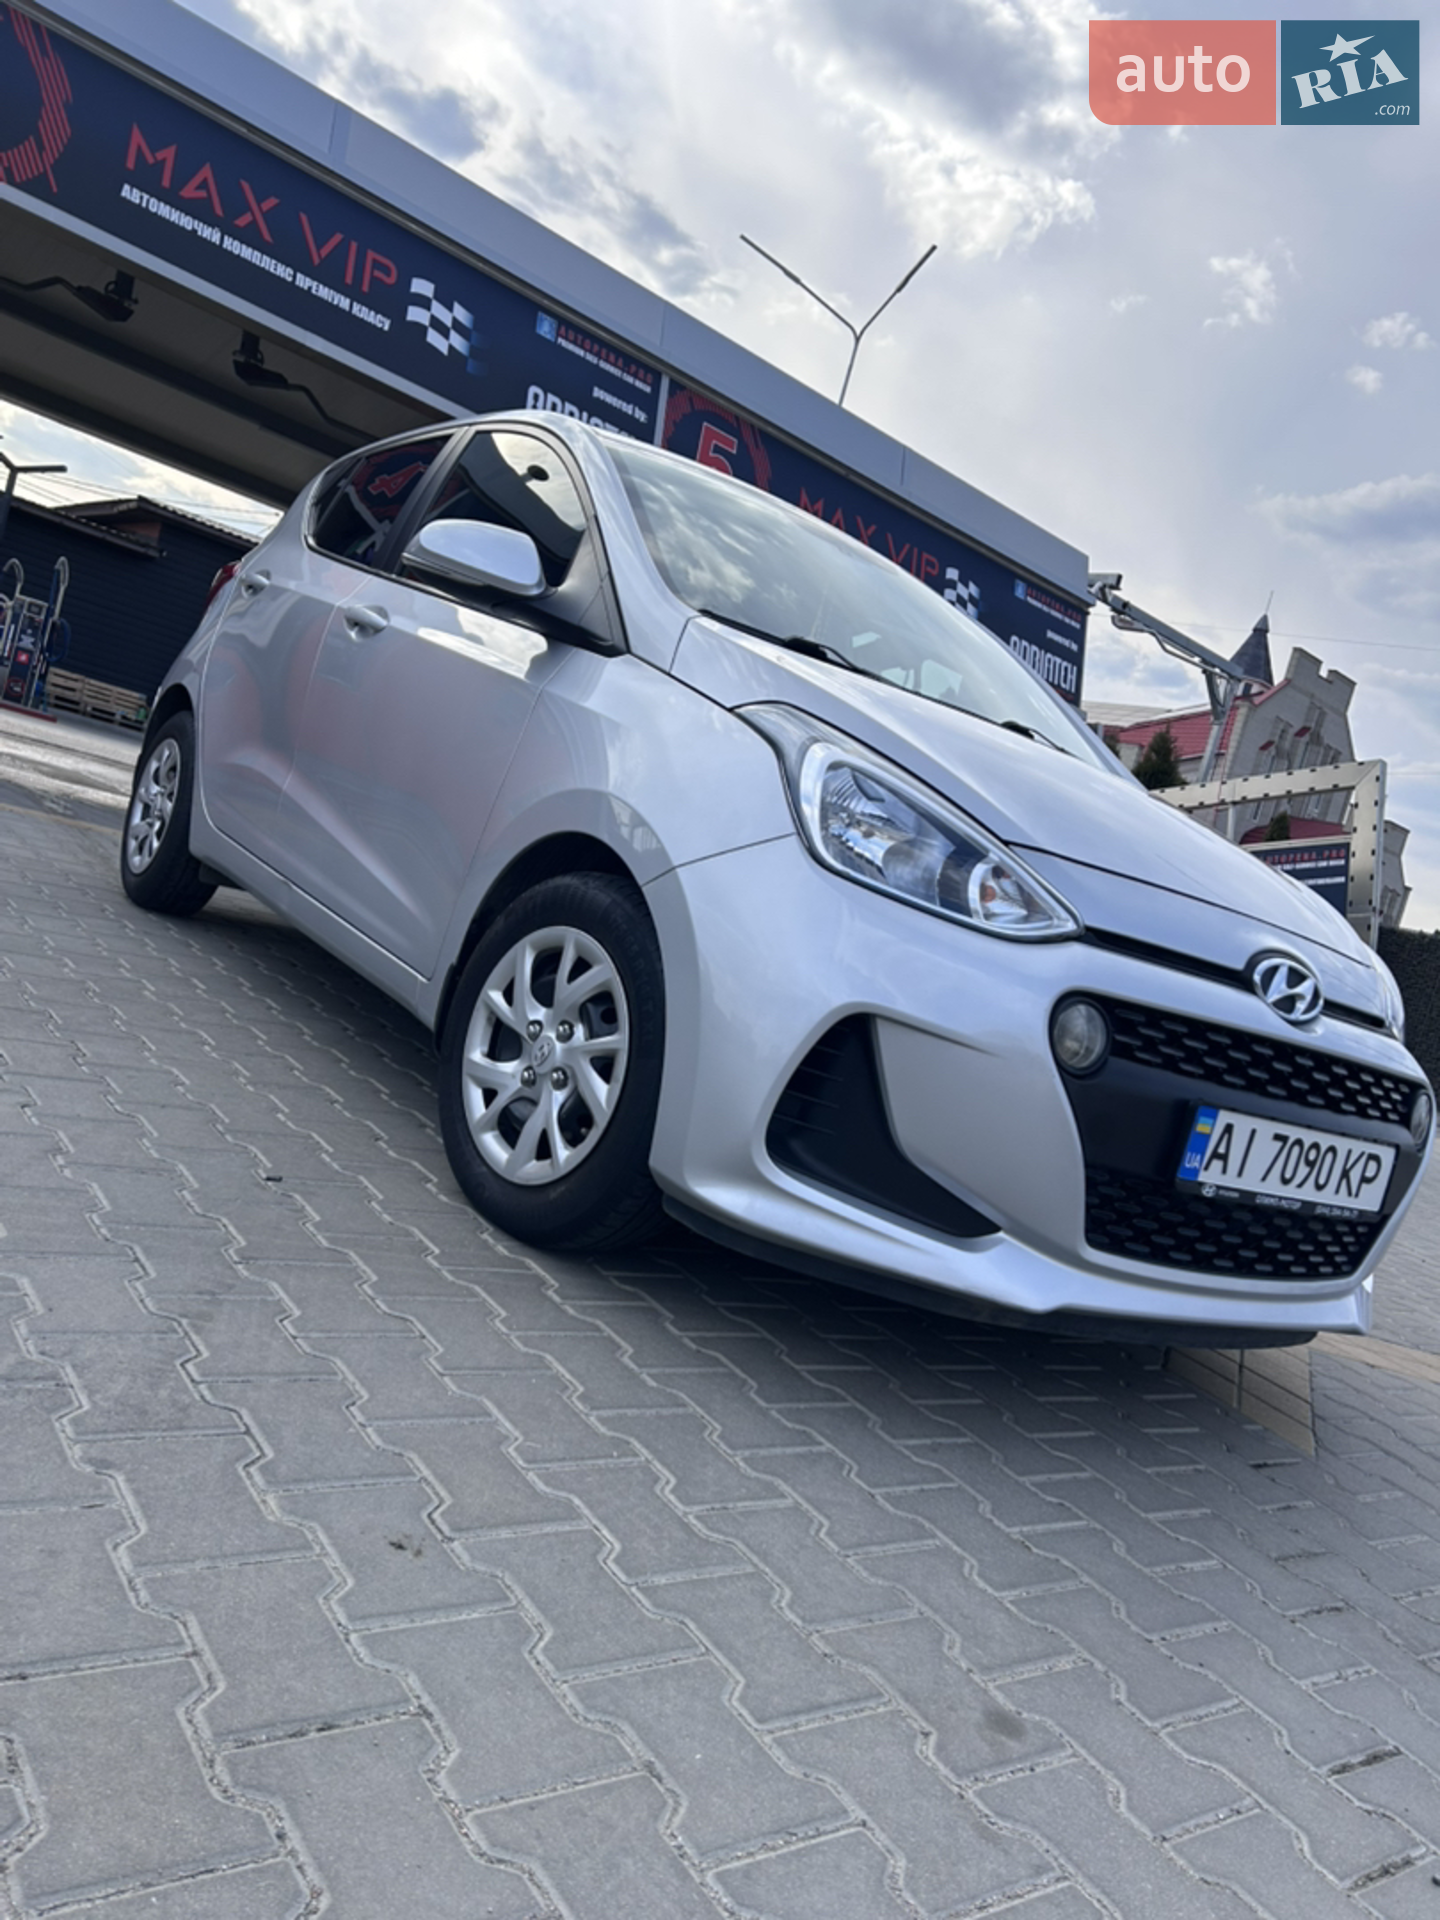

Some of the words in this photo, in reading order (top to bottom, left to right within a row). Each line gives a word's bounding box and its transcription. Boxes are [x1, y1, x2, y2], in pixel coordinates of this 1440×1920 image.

[125, 123, 280, 243] MAX
[299, 212, 398, 293] VIP
[120, 183, 221, 246] АВТОМИЮЧИЙ
[223, 234, 294, 282] КОМПЛЕКС
[295, 271, 351, 311] ПРЕМІУМ
[351, 301, 391, 331] КЛАСУ
[696, 421, 738, 477] 5
[799, 487, 877, 546] MAX
[886, 532, 940, 583] VIP
[1183, 1151, 1201, 1168] UA
[1203, 1122, 1257, 1178] AI
[1260, 1132, 1338, 1192] 7090
[1335, 1147, 1383, 1199] KP
